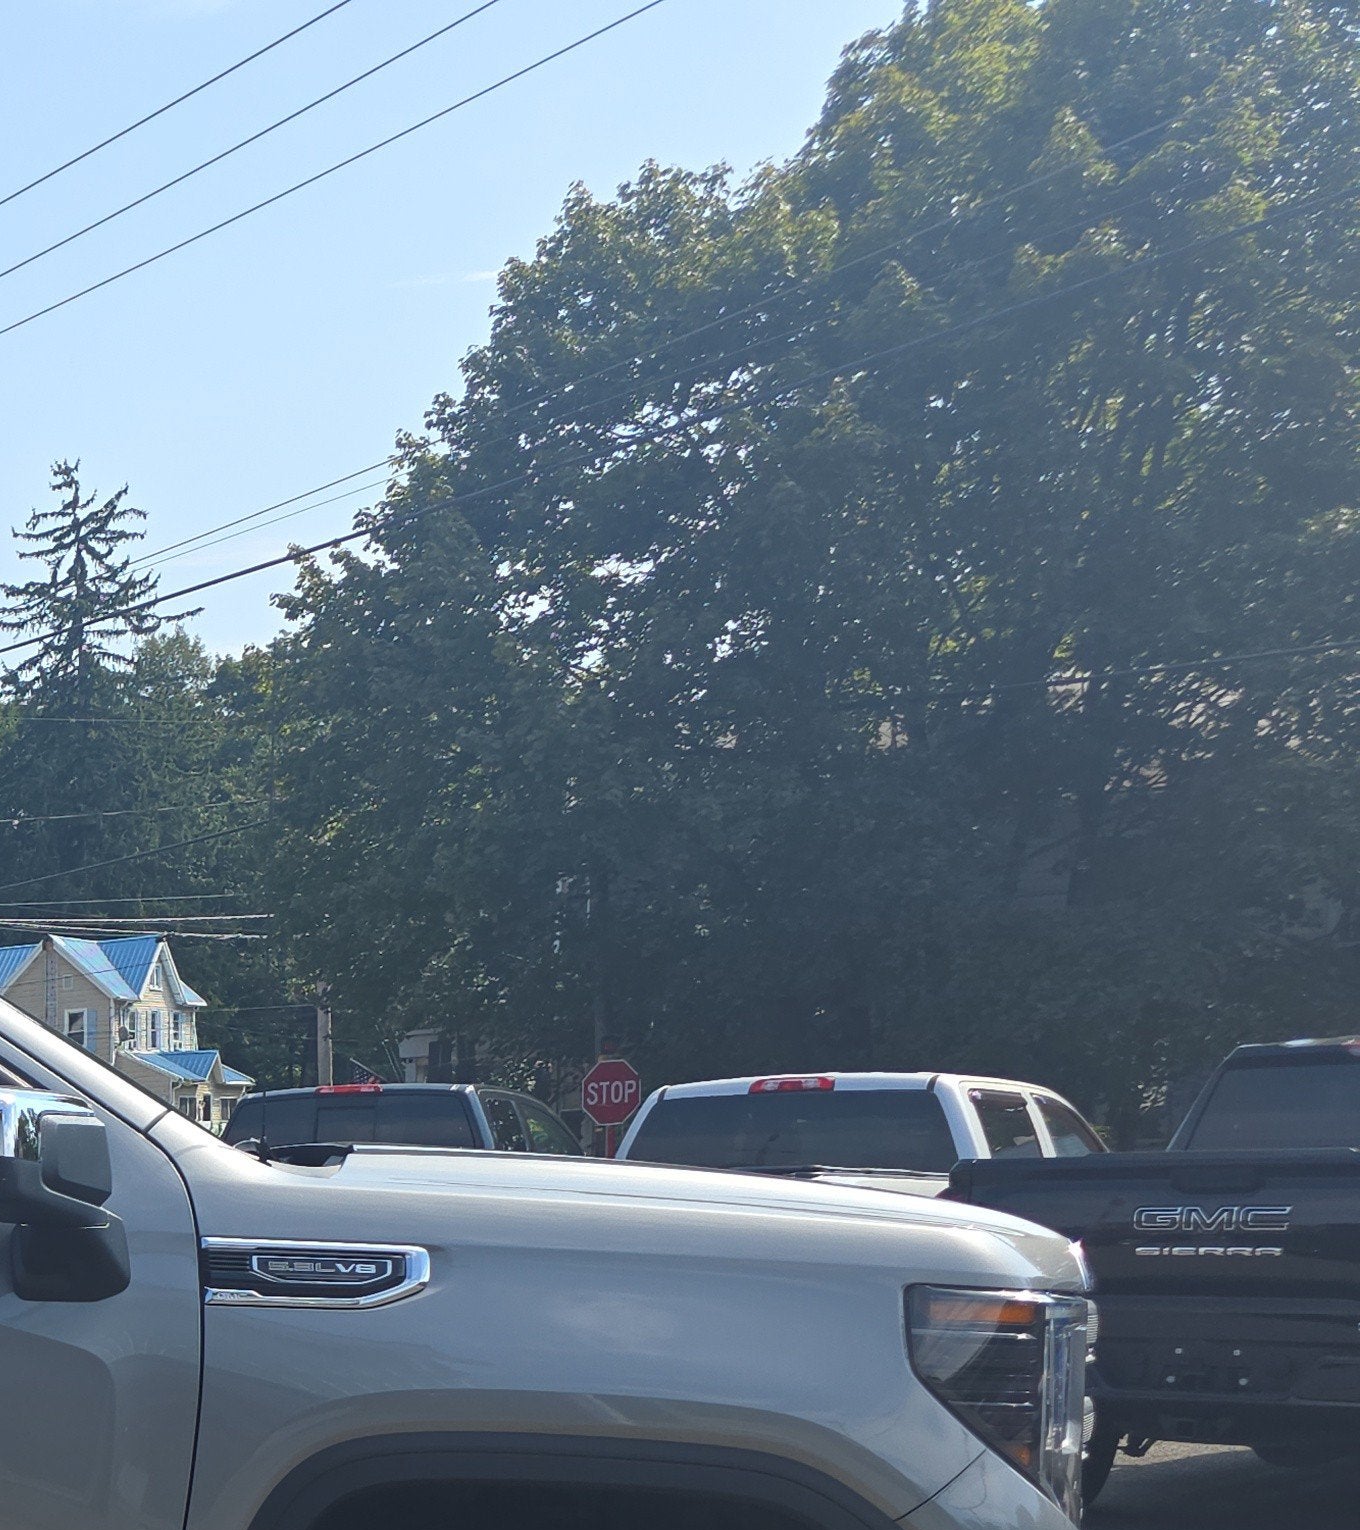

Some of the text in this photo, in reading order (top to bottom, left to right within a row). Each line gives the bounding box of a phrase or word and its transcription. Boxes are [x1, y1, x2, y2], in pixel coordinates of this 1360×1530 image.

[586, 1080, 637, 1105] STOP
[1133, 1206, 1295, 1231] GMC
[1135, 1246, 1283, 1256] SIERRA
